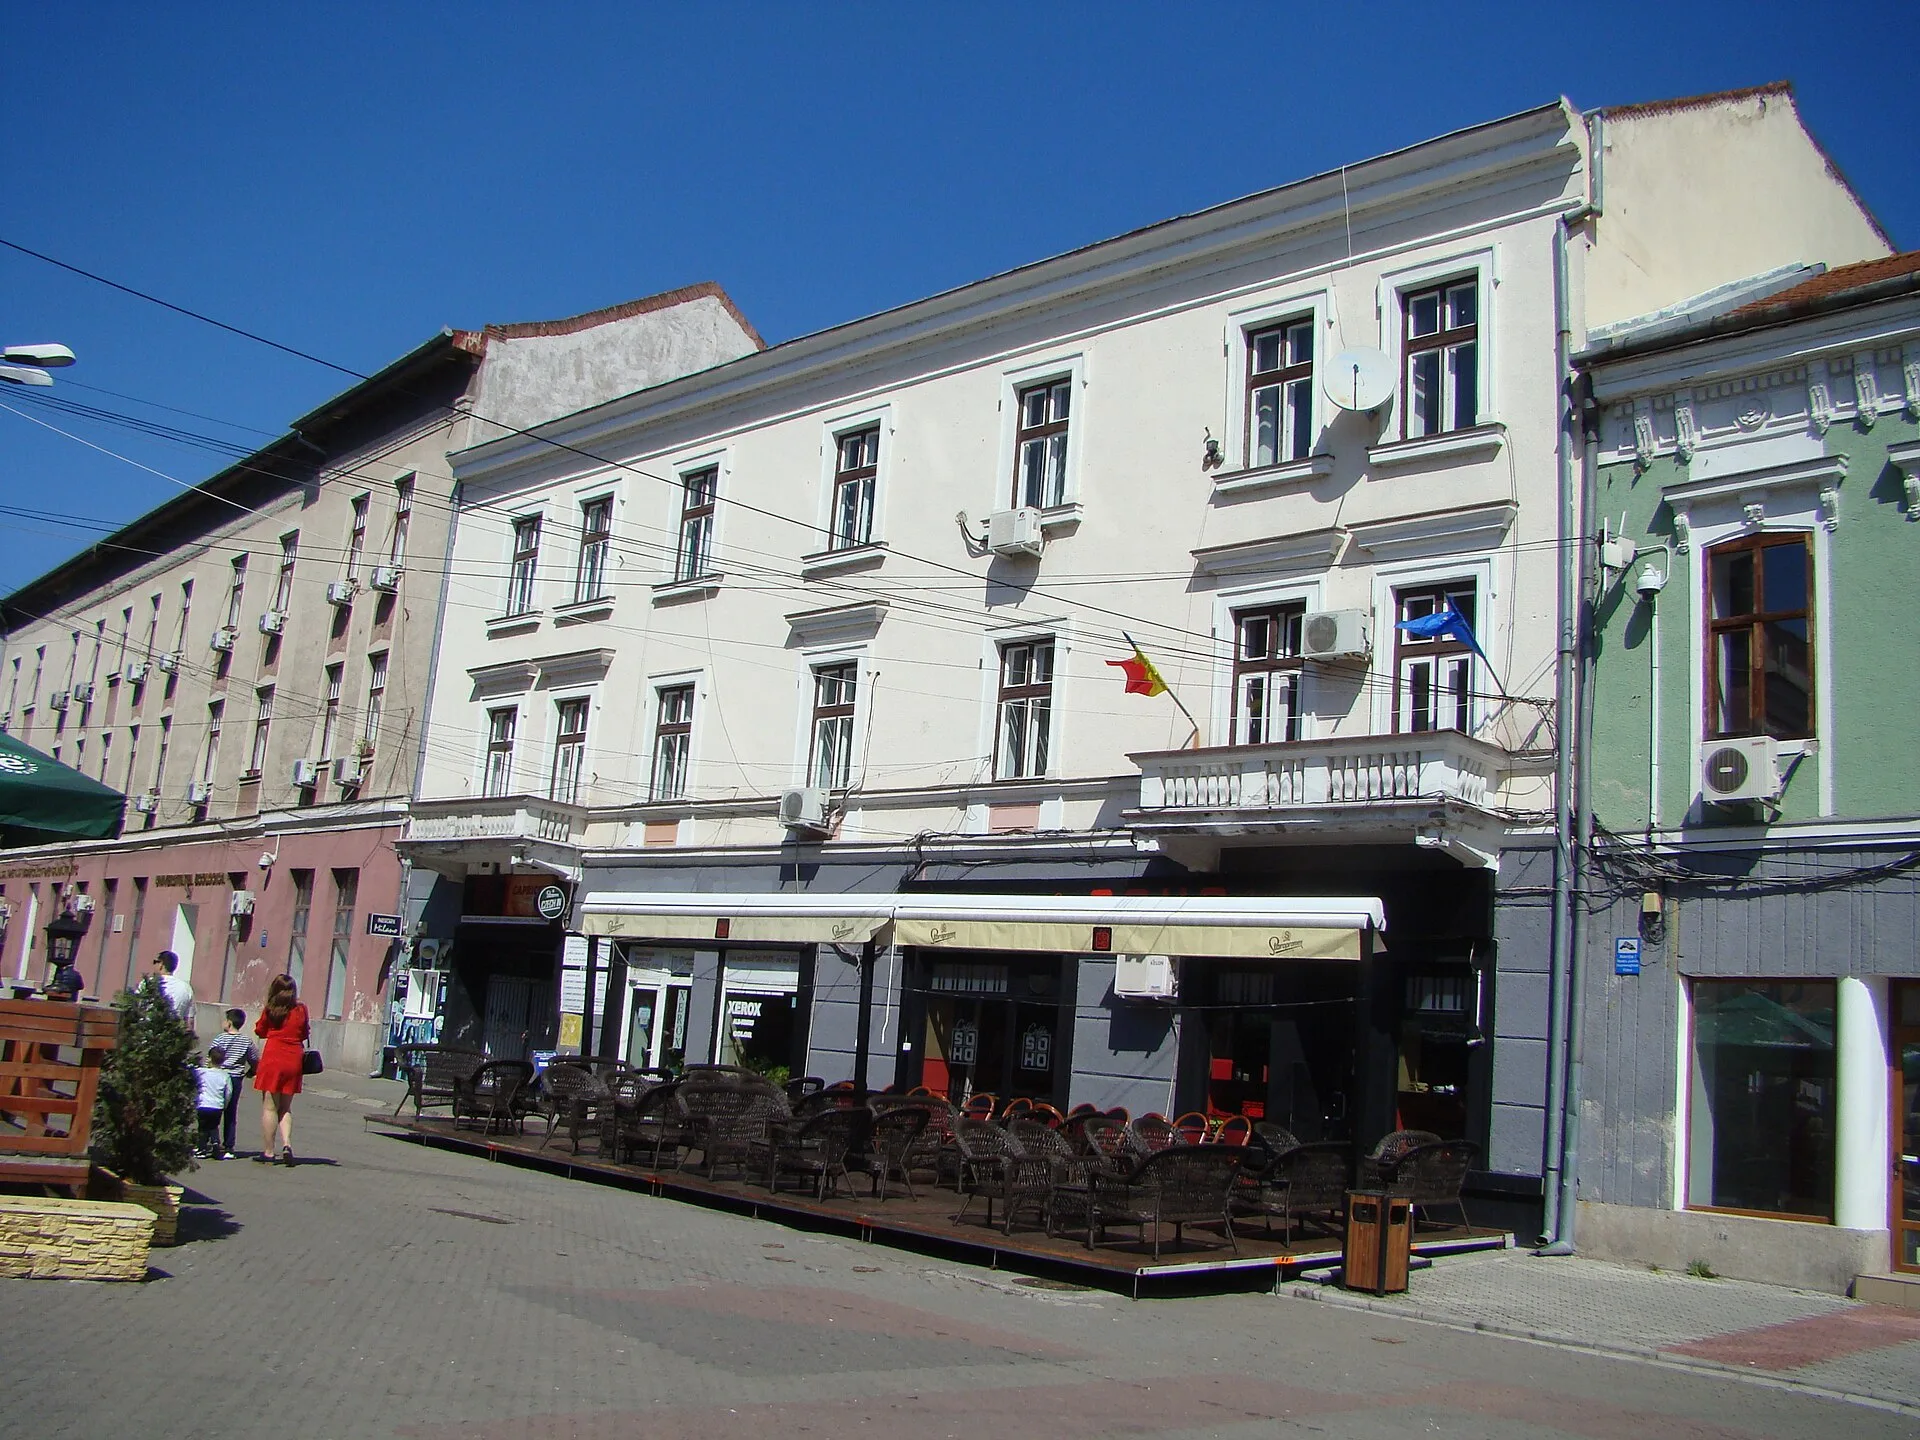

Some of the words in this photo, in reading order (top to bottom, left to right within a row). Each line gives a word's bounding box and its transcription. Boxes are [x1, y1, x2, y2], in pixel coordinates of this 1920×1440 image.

[373, 923, 398, 934] Milano
[727, 1000, 763, 1017] XEROX
[674, 990, 686, 1048] XEROX
